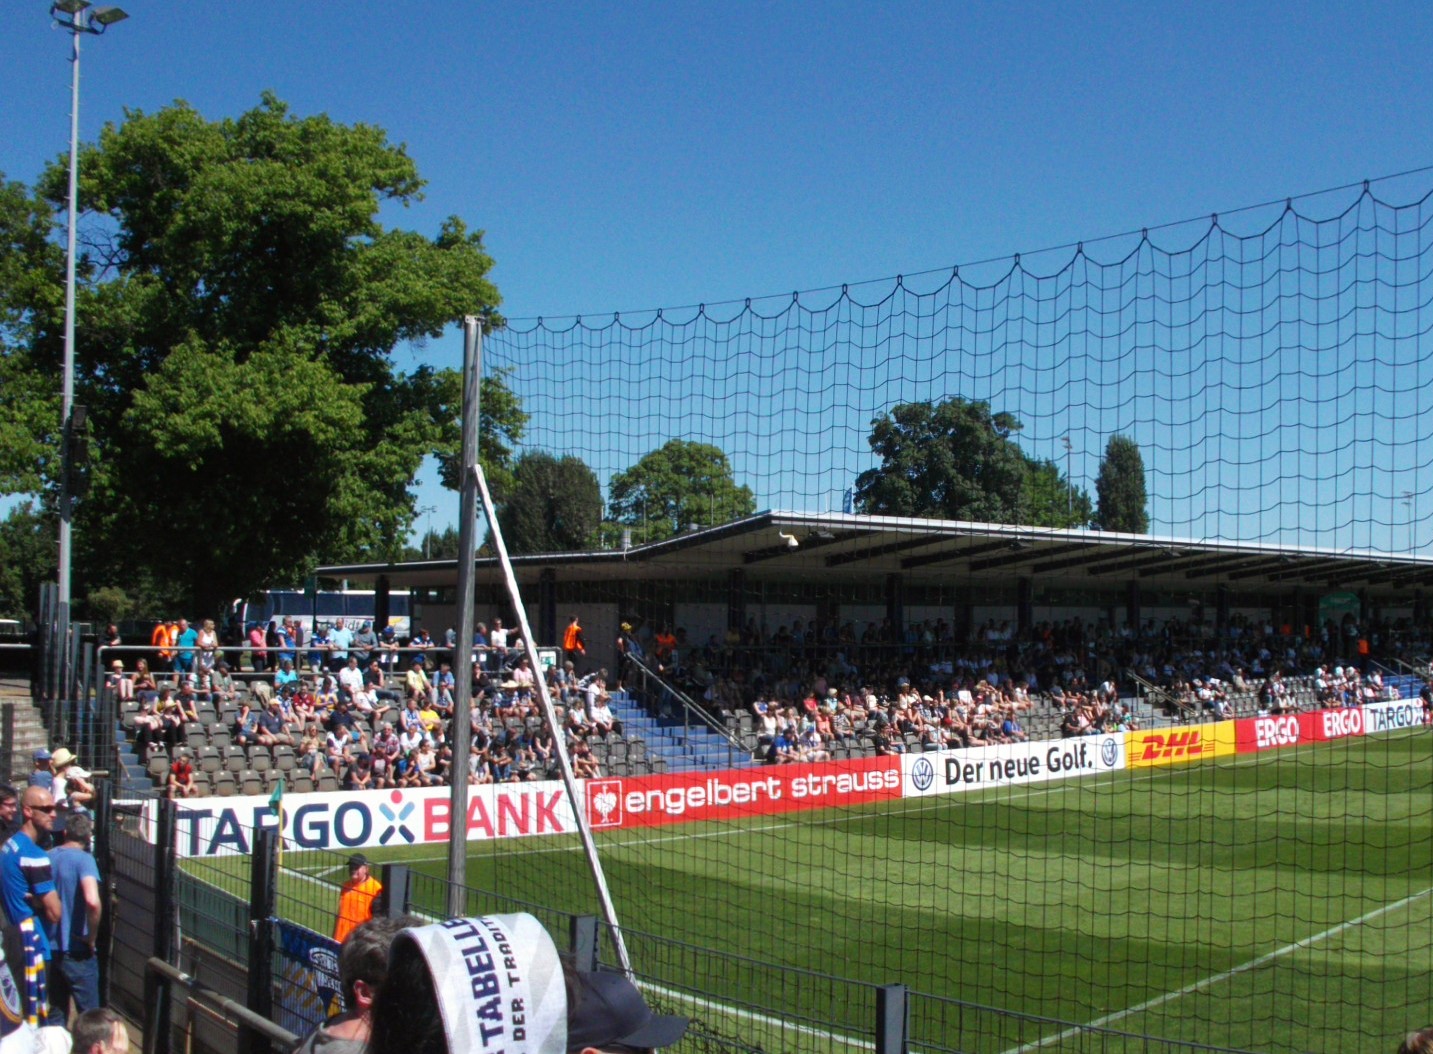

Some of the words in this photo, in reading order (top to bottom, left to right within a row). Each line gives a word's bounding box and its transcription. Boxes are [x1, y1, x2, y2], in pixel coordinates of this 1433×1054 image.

[1255, 715, 1300, 748] ERGO
[1323, 708, 1362, 738] ERGO
[1370, 704, 1413, 731] TARGO
[945, 758, 984, 786] Der
[990, 755, 1041, 780] neue
[1047, 742, 1093, 773] Golf.
[1142, 730, 1203, 761] DHL
[625, 776, 782, 815] engelbert
[790, 767, 901, 799] strauss
[176, 801, 373, 856] TARGO
[423, 790, 565, 842] BANK
[441, 918, 505, 1047] TABELLE
[511, 998, 526, 1041] DER
